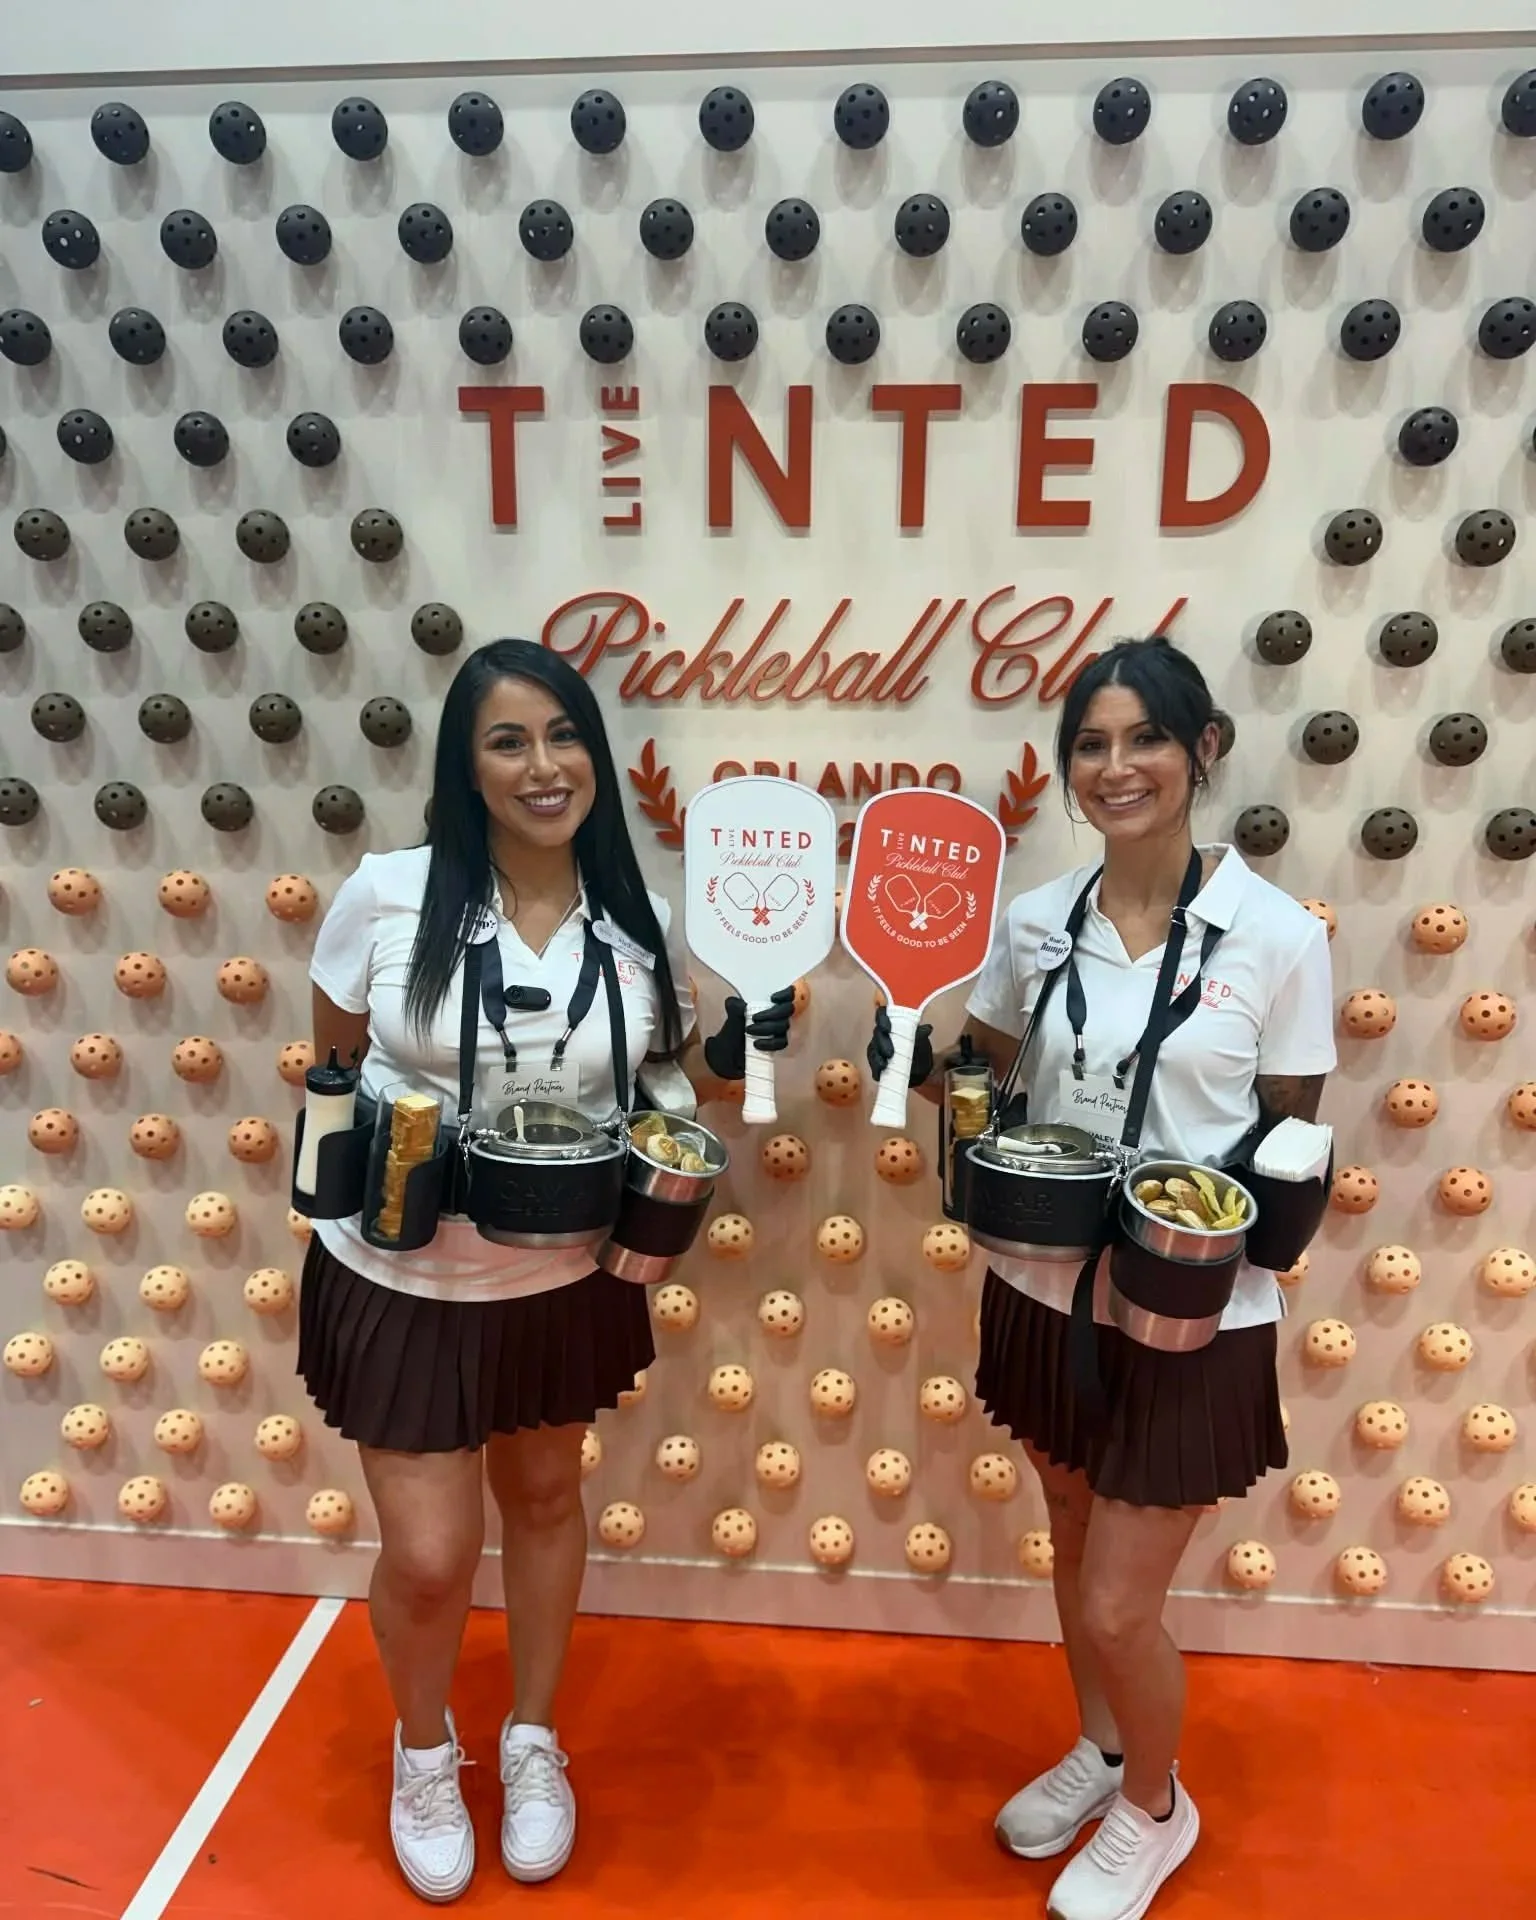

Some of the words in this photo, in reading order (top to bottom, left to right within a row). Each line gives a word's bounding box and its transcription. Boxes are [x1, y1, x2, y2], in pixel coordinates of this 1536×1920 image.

[601, 386, 642, 527] LIVE
[541, 591, 967, 702] Pickleball
[720, 851, 775, 868] Pickleball
[775, 852, 803, 869] Club
[885, 851, 942, 875] Pickleball
[940, 861, 970, 881] Club
[714, 908, 723, 918] IT
[719, 916, 742, 938] FEELS
[742, 932, 768, 944] GOOD
[769, 933, 782, 944] TO
[781, 928, 794, 939] BE
[792, 909, 809, 931] SEEN
[872, 904, 881, 914] IT
[877, 913, 897, 937] FEELS
[896, 932, 924, 949] GOOD
[923, 938, 937, 949] TO
[937, 936, 950, 947] BE
[947, 921, 967, 940] SEEN
[502, 1079, 532, 1096] Brand
[532, 1077, 566, 1096] Partner
[1071, 1087, 1099, 1109] Brand
